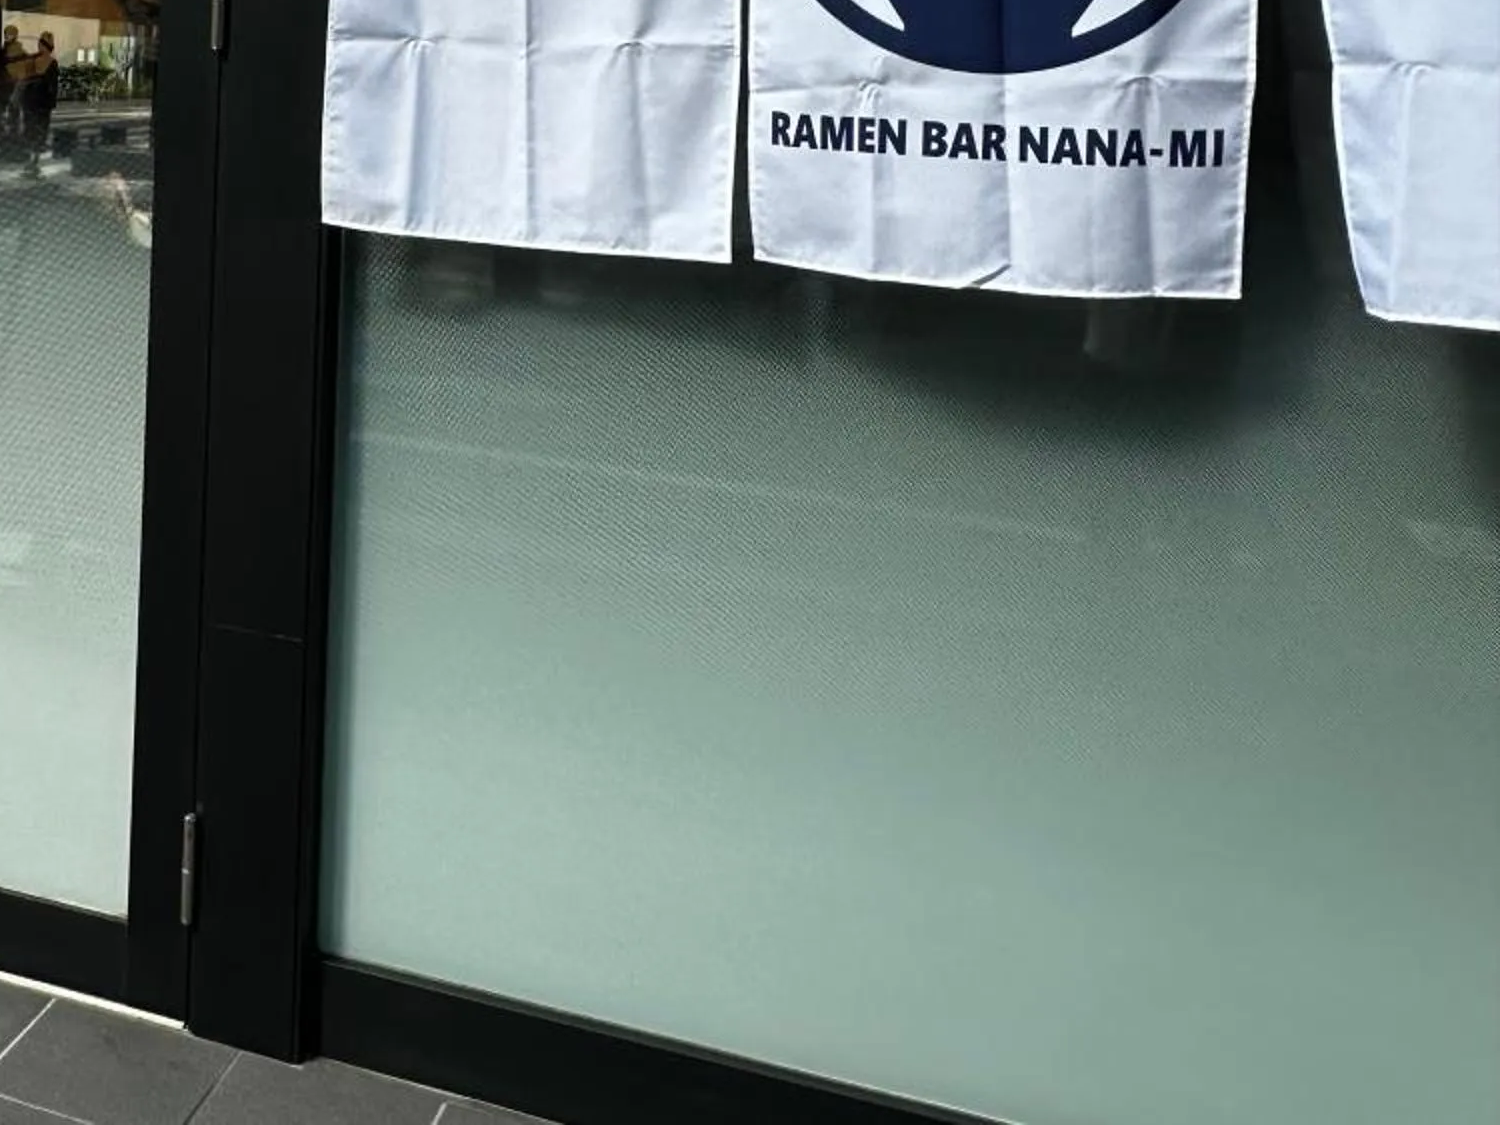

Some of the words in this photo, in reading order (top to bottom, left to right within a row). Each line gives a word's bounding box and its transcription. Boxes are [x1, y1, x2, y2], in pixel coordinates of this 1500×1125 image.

[771, 111, 907, 155] RAMEN
[922, 121, 1006, 161] BAR
[1019, 126, 1224, 168] NANA-MI
